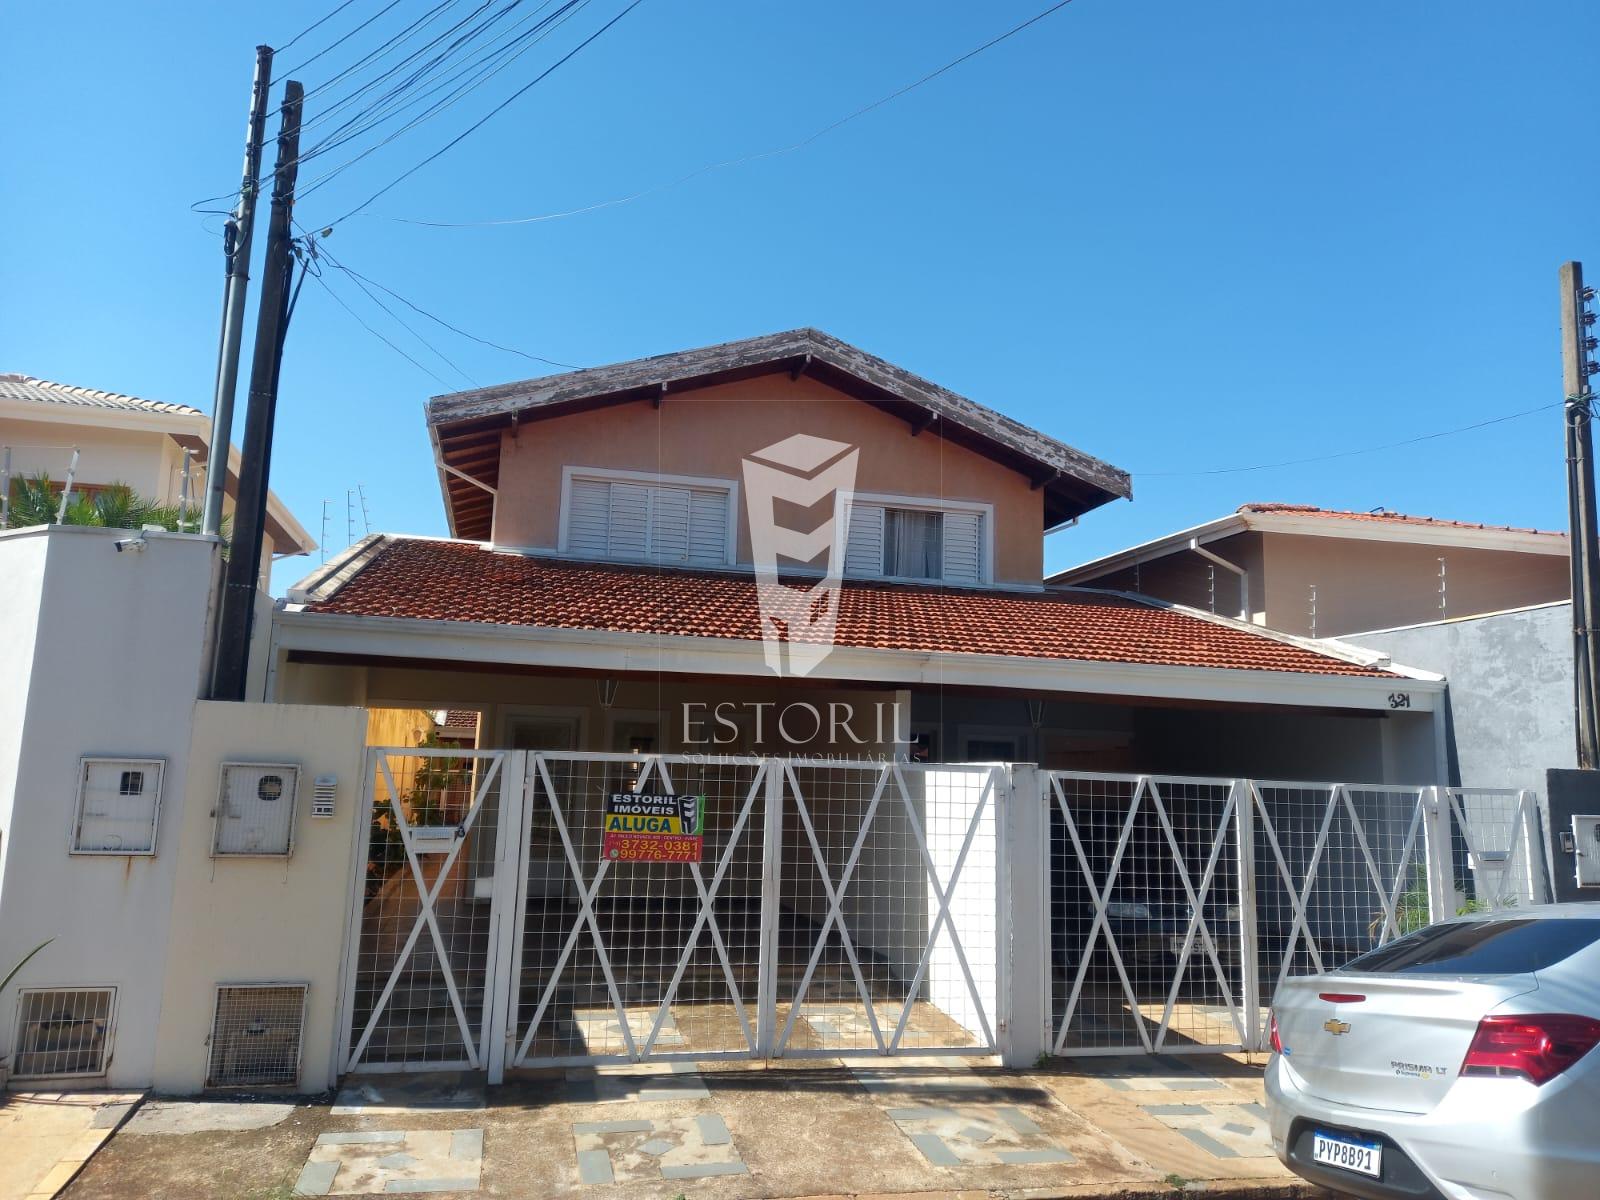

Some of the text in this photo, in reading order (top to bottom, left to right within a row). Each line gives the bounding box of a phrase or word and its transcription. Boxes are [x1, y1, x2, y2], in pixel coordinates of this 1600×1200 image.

[612, 794, 677, 805] ESTORIL
[614, 804, 674, 815] IMÓVEIS
[609, 816, 672, 833] ALUGA
[621, 839, 698, 851] 3732-0381
[620, 849, 698, 860] 99776-7771
[1391, 1061, 1433, 1074] PRISMA
[1435, 1066, 1448, 1075] LT
[1319, 1139, 1372, 1171] PYP8B91
